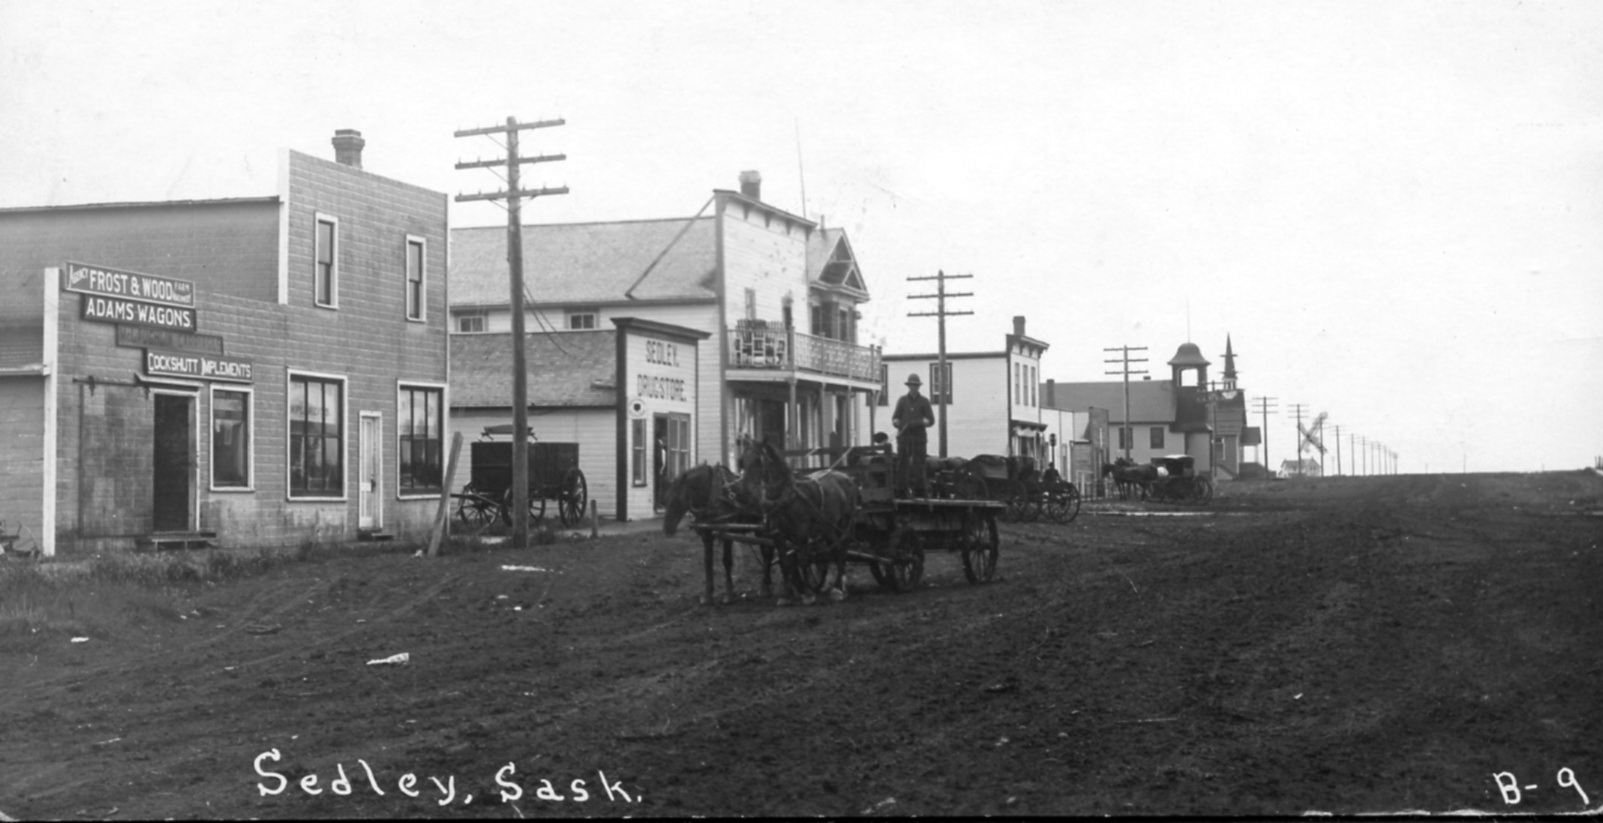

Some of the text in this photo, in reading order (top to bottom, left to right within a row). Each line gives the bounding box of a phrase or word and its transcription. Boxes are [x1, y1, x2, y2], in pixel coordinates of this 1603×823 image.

[90, 269, 128, 294] FROST
[130, 276, 140, 296] &
[142, 277, 173, 300] WOOD
[86, 298, 134, 320] ADAMS
[148, 352, 251, 378] COCKSHUTT IMPLEMENTS
